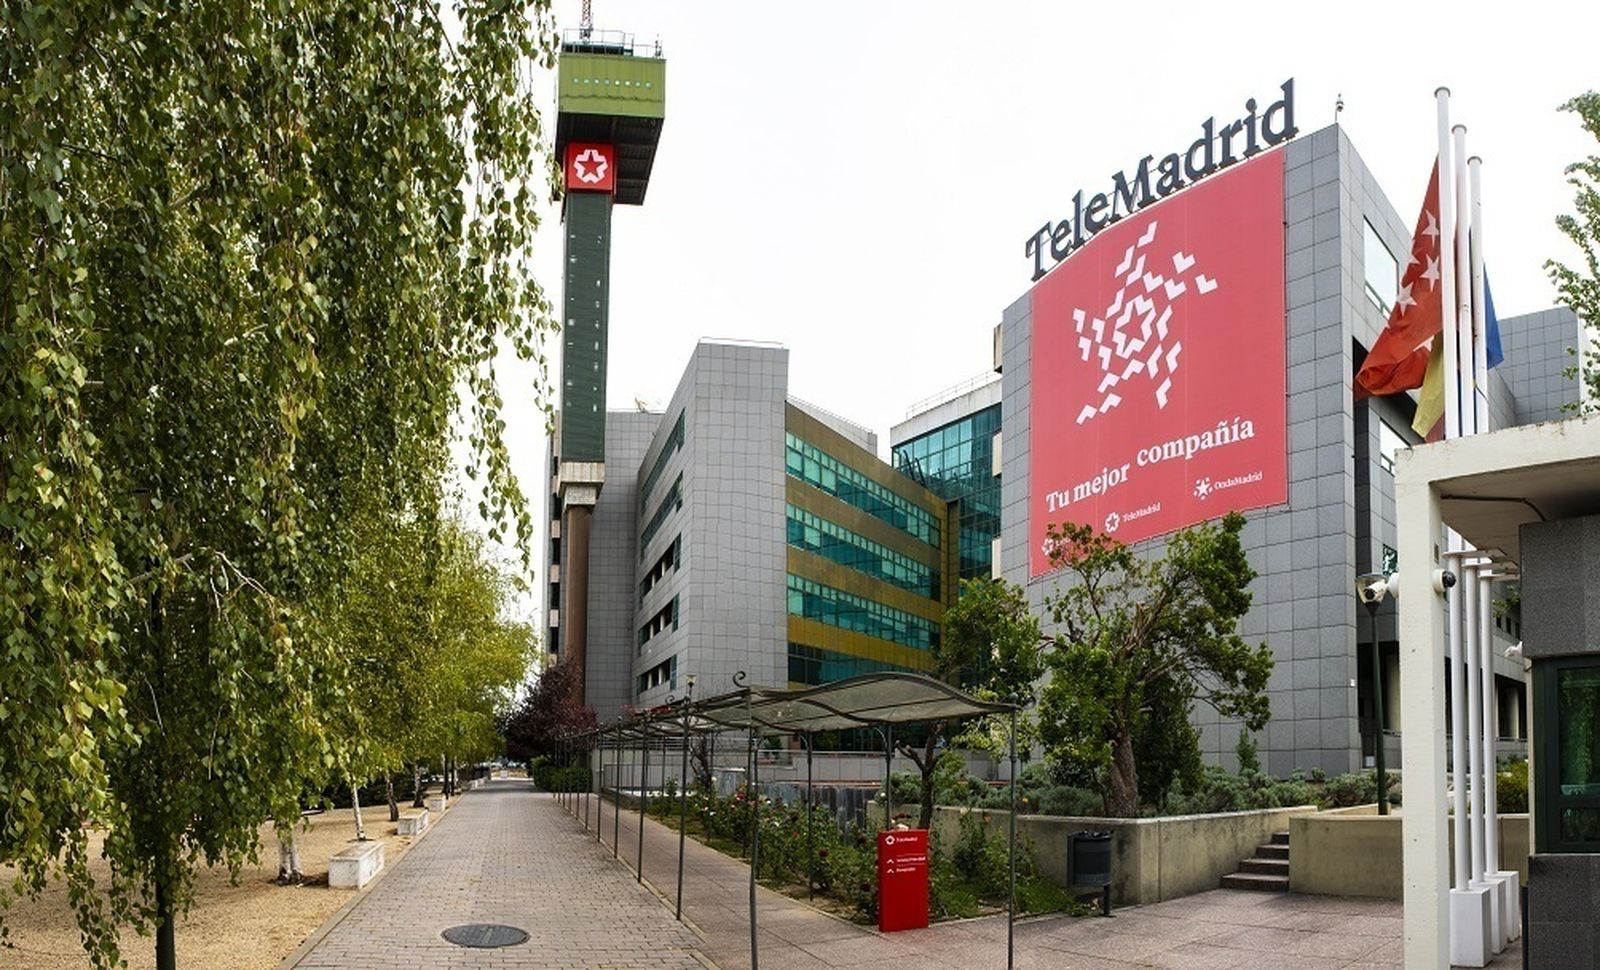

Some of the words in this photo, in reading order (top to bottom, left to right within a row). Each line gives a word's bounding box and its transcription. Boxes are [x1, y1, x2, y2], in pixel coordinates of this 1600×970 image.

[1025, 77, 1299, 282] TeleMadrid
[1046, 491, 1070, 513] Tu
[1073, 463, 1130, 503] mejor
[1136, 416, 1255, 467] compañía
[1214, 470, 1263, 490] OndaMadrid
[1122, 501, 1161, 522] TeleMadrid
